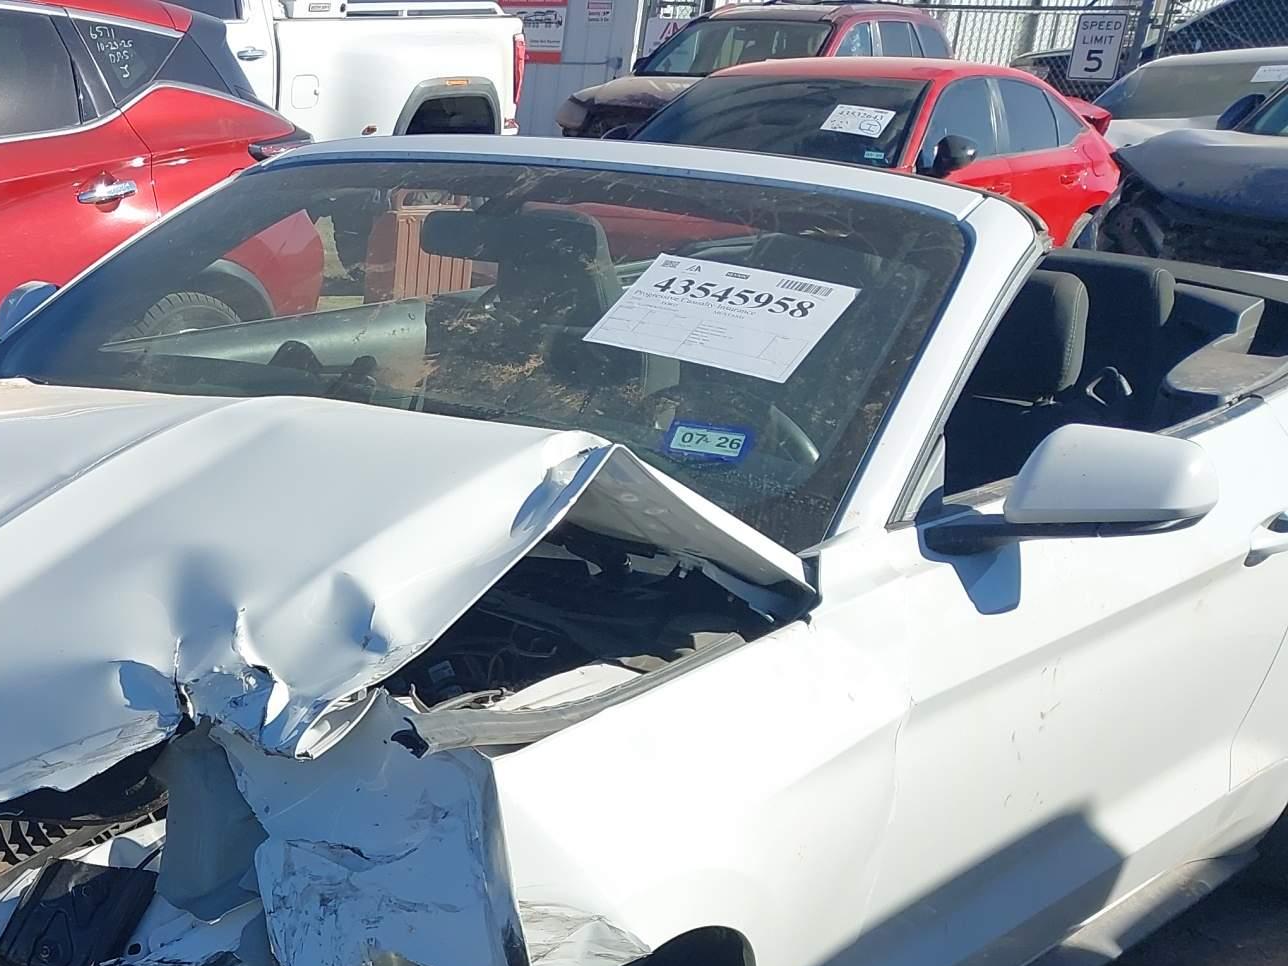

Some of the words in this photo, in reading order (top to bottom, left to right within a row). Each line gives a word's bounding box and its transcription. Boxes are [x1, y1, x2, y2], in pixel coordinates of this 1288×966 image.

[1081, 20, 1122, 31] SPEED
[1081, 35, 1115, 45] LIMIT
[1083, 49, 1104, 73] 5
[654, 276, 816, 319] 43545958
[717, 303, 757, 316] Insurance
[681, 432, 707, 445] 07
[715, 436, 743, 450] 26
